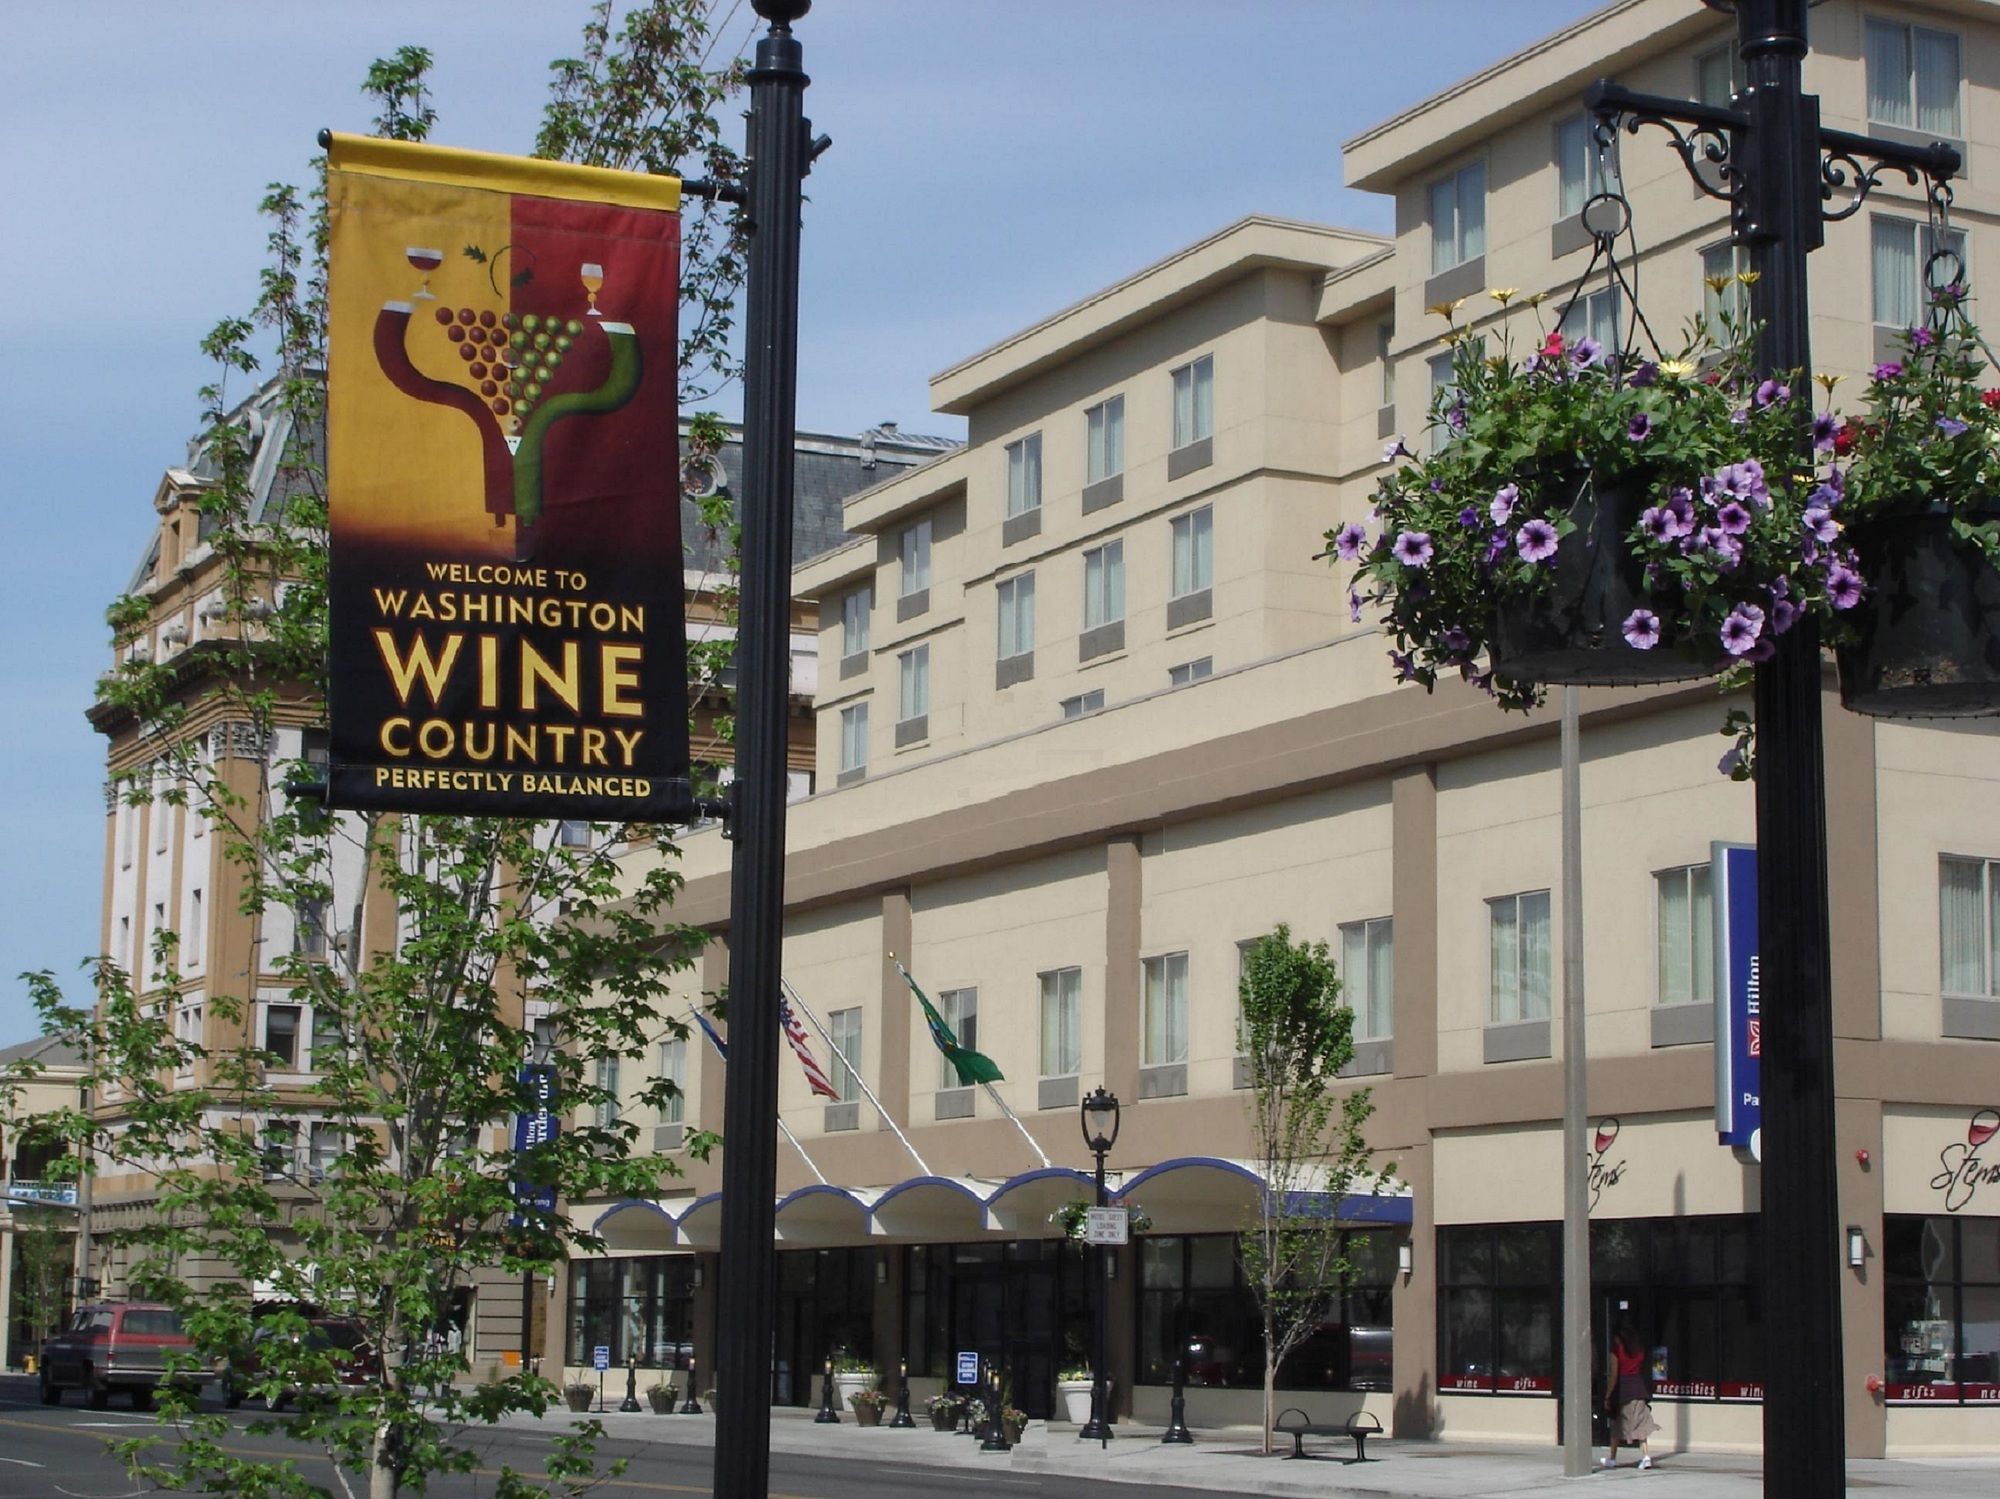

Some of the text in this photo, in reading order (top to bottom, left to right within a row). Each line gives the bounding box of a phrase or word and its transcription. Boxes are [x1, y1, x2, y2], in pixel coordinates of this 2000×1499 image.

[426, 562, 587, 591] WELCOME TO
[374, 588, 644, 633] WASHINGTON
[375, 630, 643, 716] WINE
[380, 717, 643, 766] COUNTRY
[376, 767, 651, 797] PERFECTLY BALANCED
[1456, 1376, 1478, 1389] wine
[1514, 1377, 1537, 1390] gifts
[1656, 1382, 1716, 1396] necessities
[1903, 1385, 1936, 1399] gifts
